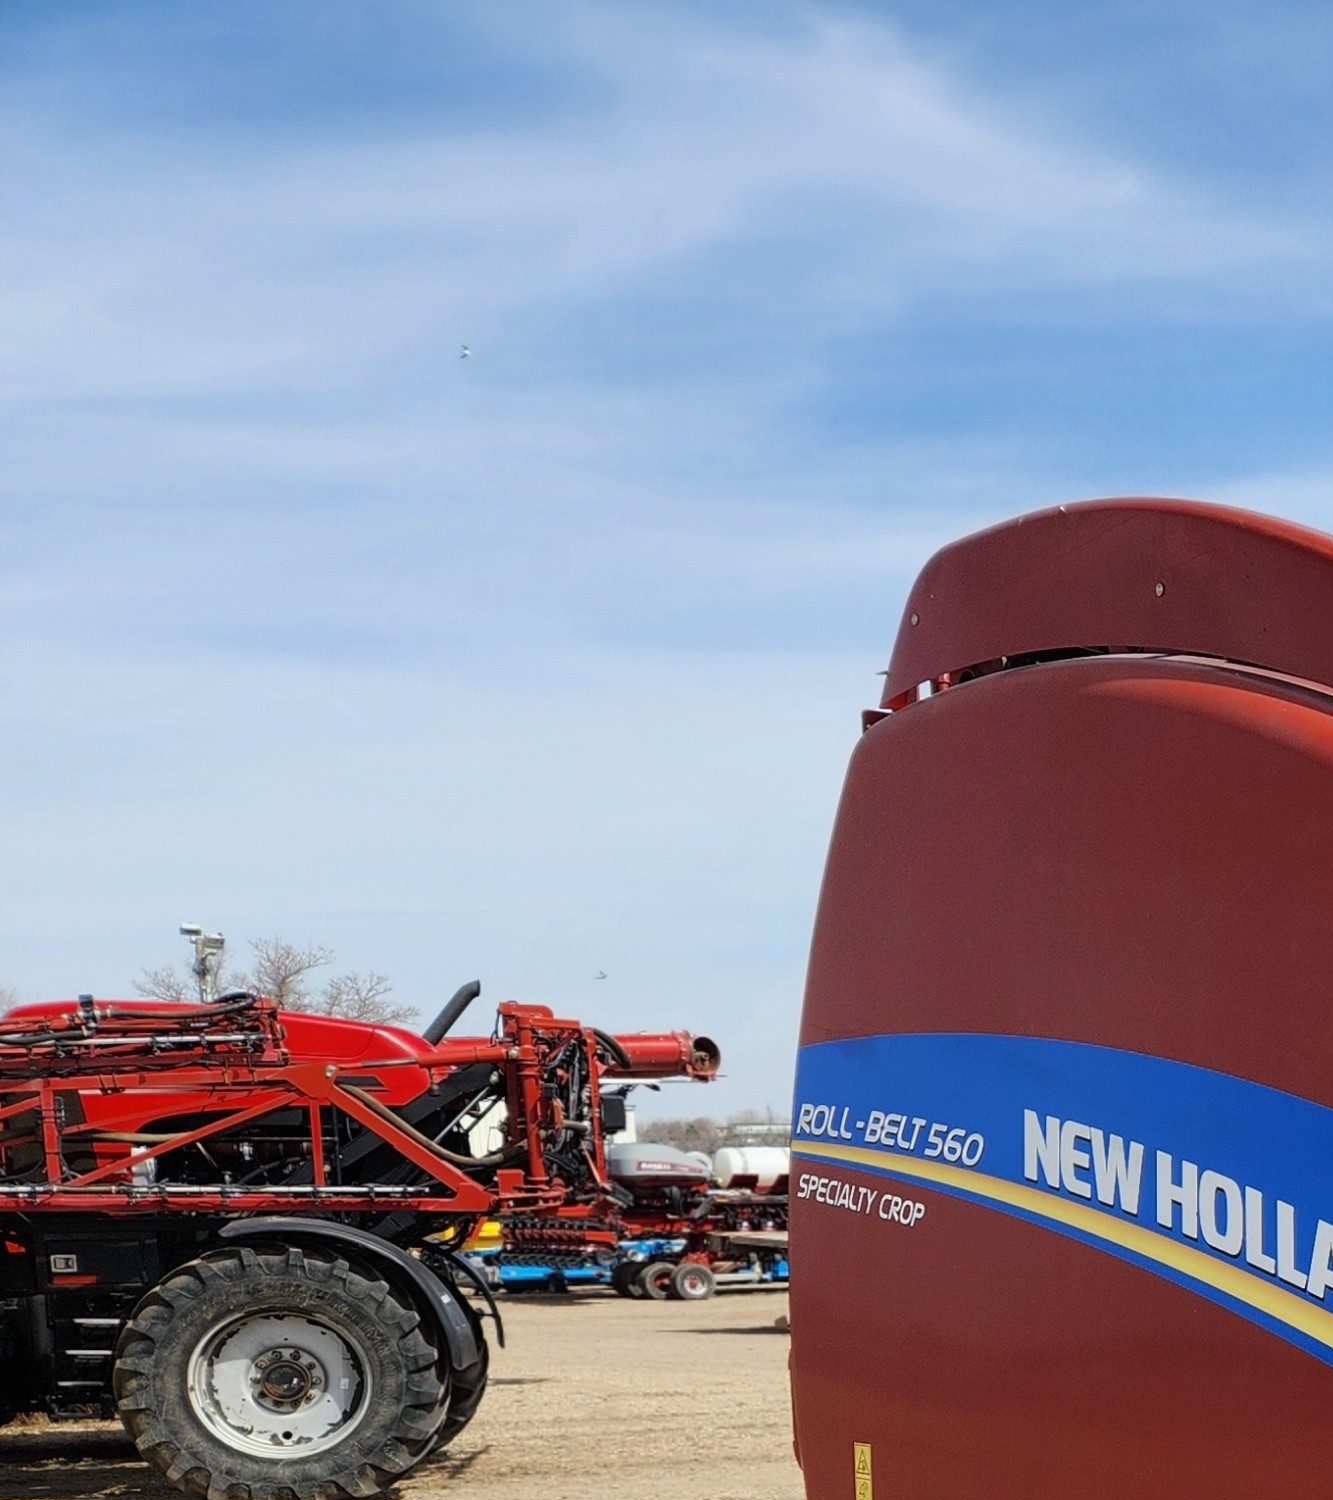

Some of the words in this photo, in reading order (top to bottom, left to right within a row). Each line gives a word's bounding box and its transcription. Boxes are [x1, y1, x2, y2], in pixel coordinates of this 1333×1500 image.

[924, 1122, 984, 1166] 560
[1024, 1108, 1145, 1216] NEW
[797, 1174, 878, 1214] SPECIALTY
[878, 1194, 925, 1227] CROP
